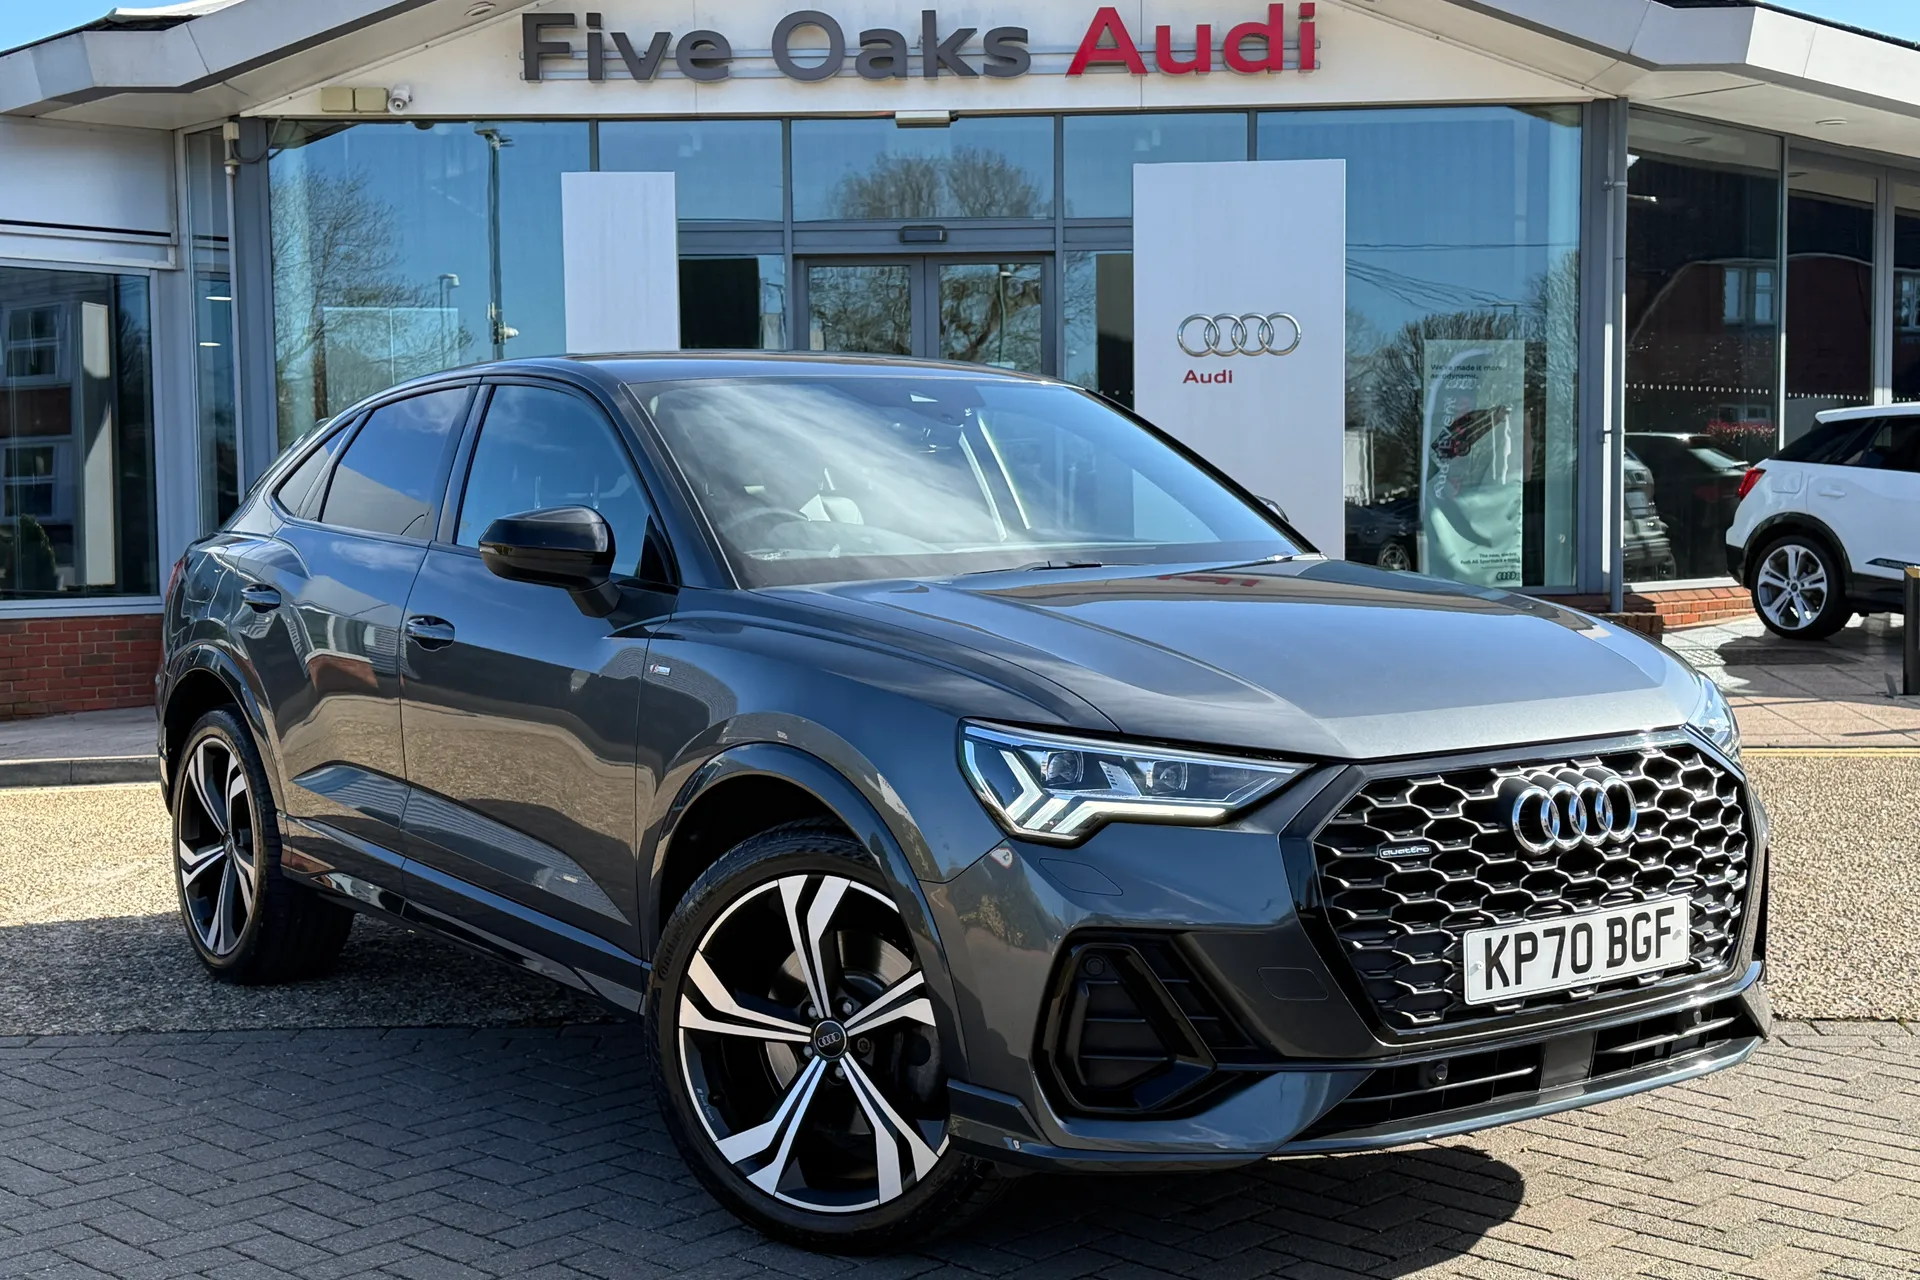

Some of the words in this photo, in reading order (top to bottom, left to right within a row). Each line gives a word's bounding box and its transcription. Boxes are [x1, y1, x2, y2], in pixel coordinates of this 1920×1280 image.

[522, 12, 733, 82] Five
[772, 10, 1031, 82] Oaks
[1065, 2, 1315, 77] Audi
[1182, 369, 1233, 384] Audi
[1382, 845, 1430, 857] quattro
[1484, 922, 1593, 991] KP70
[1606, 906, 1675, 969] BGF
